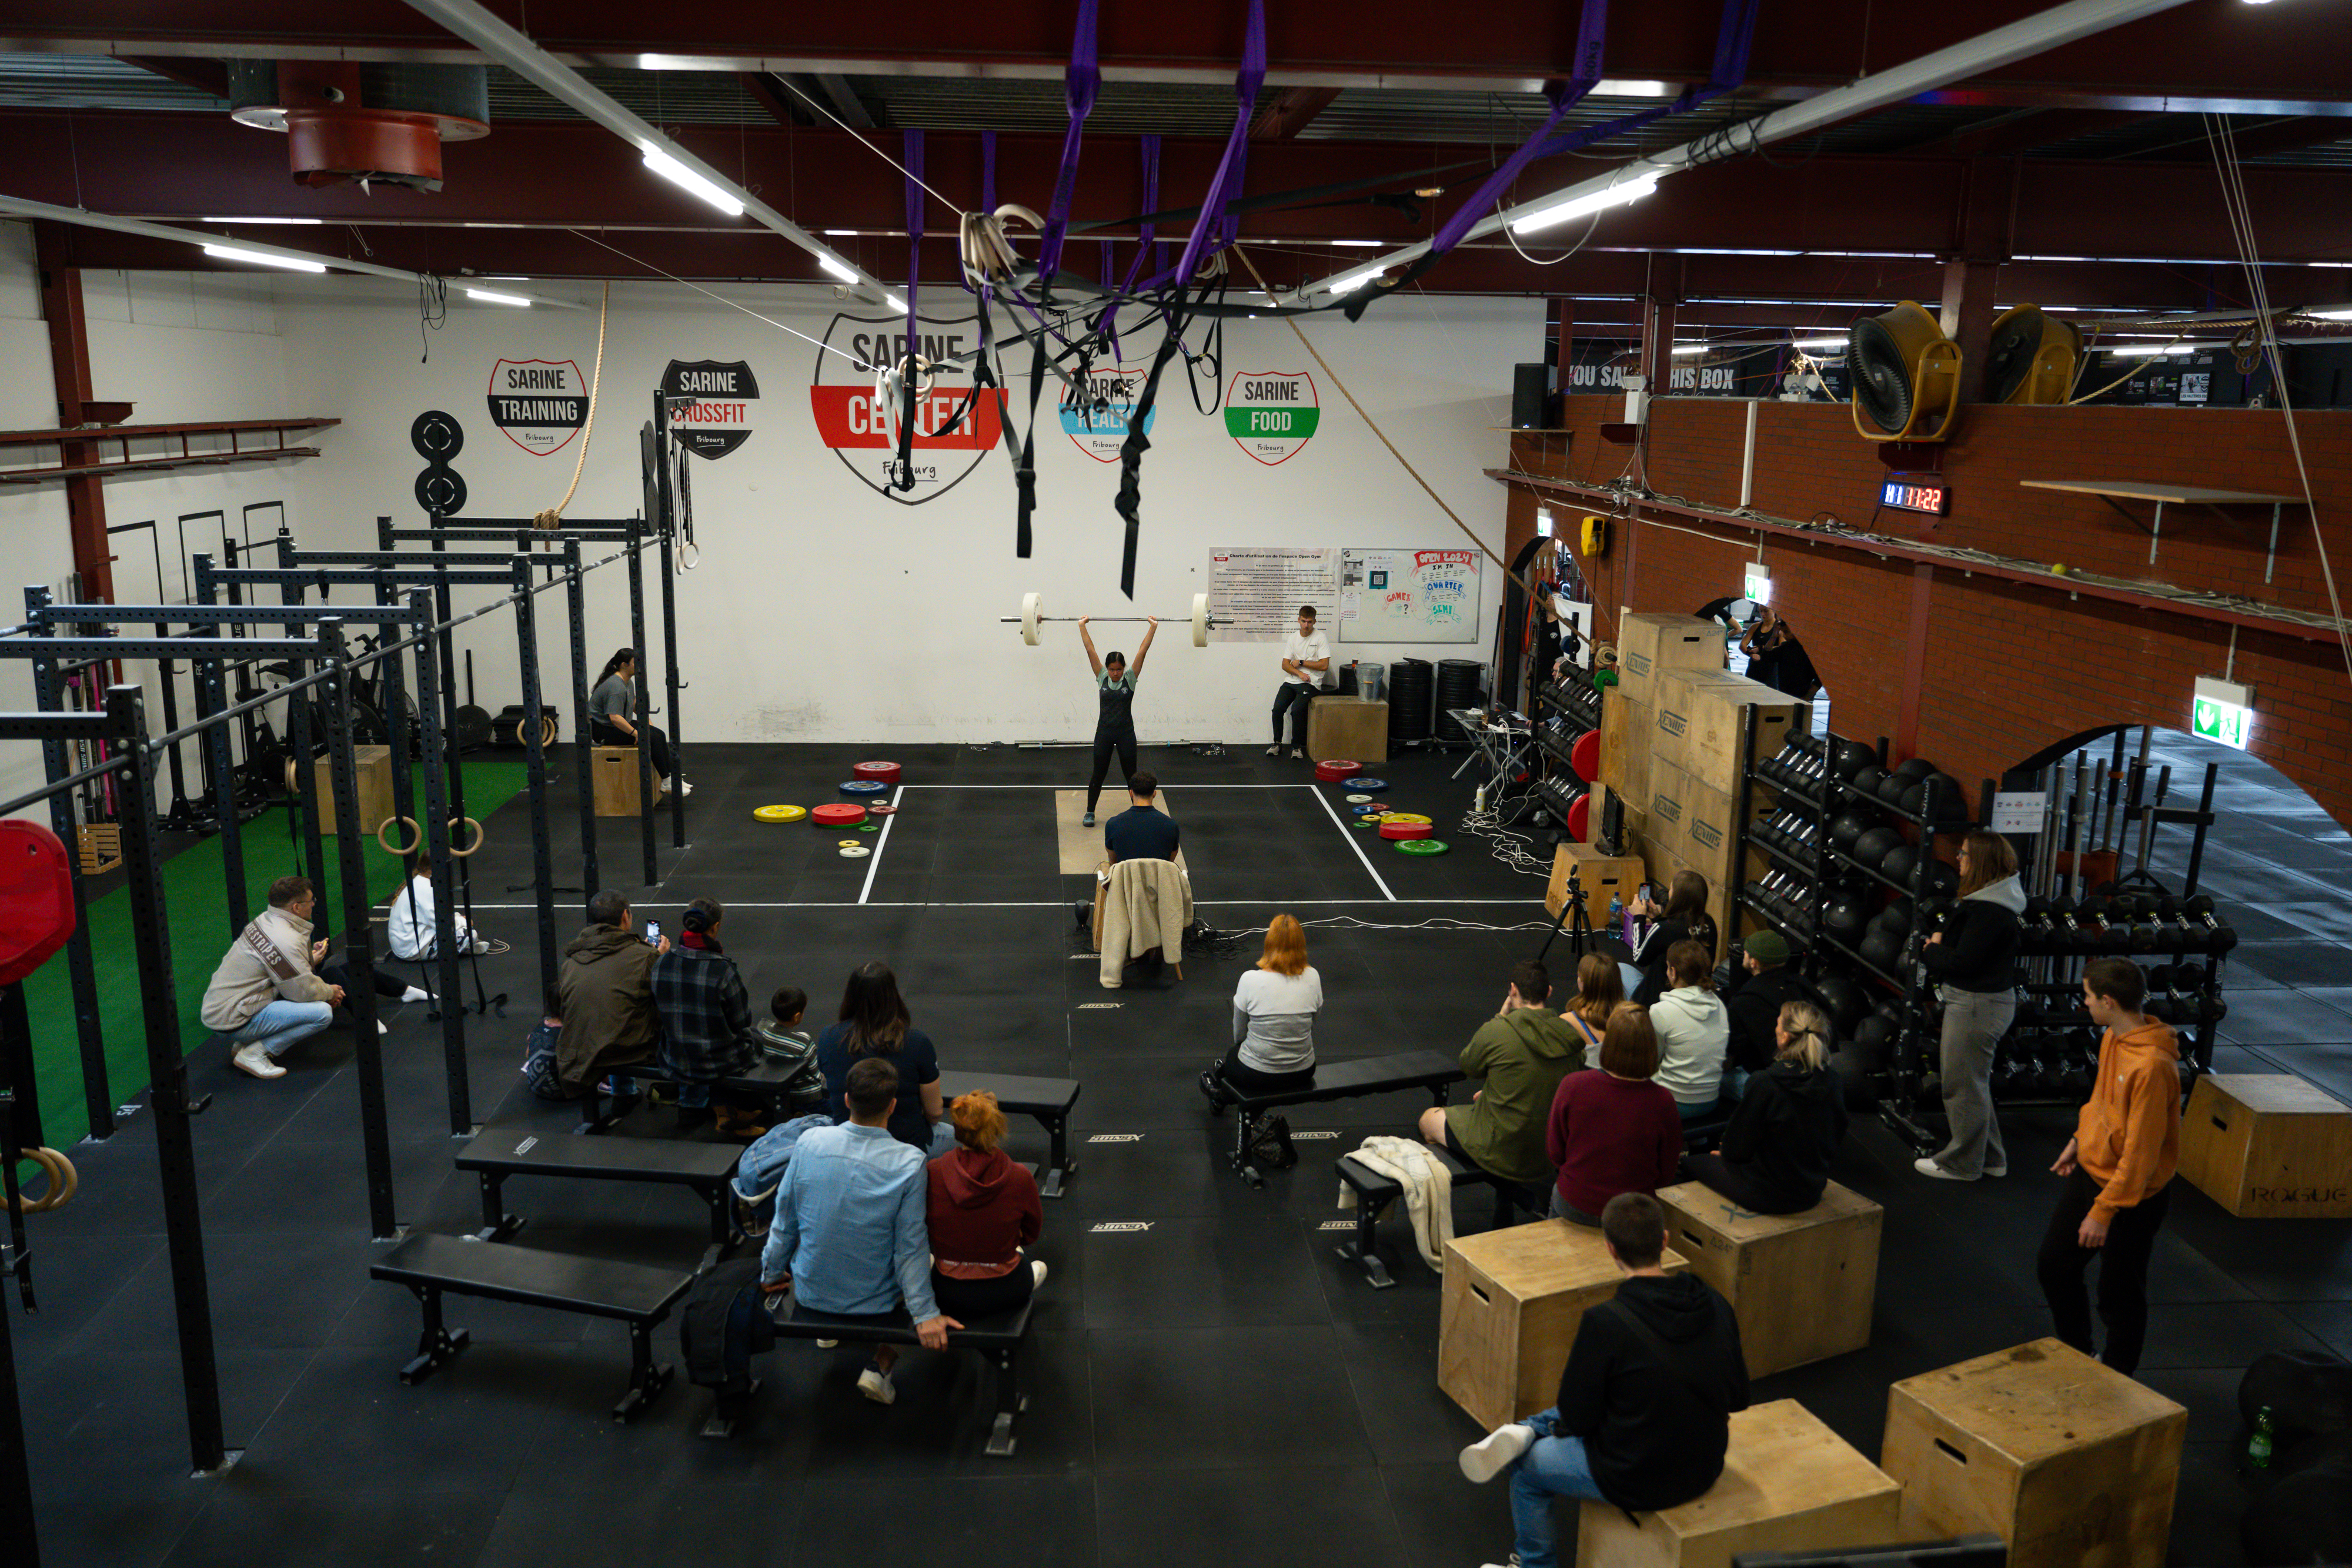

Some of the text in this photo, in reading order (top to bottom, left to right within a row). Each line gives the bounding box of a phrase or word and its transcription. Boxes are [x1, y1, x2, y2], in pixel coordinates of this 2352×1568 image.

[507, 369, 566, 390] SARINE
[680, 371, 737, 392] SARINE
[1671, 369, 1695, 389] HIS
[1700, 369, 1734, 389] BOX
[1245, 381, 1299, 401] SARINE
[499, 400, 577, 421] TRAINING
[1251, 412, 1291, 432] FOOD
[526, 433, 554, 443] Fribourg
[696, 435, 724, 444] Fribourg
[1093, 440, 1120, 450] Fribourg
[1257, 443, 1284, 452] Fribourg
[1419, 553, 1469, 563] OPEN 2024
[1427, 581, 1462, 592] QUARTER
[1387, 591, 1411, 602] GAMES
[1432, 604, 1452, 615] SEMI
[1623, 651, 1652, 677] XENIUS
[1656, 708, 1688, 738] XENIUS
[1651, 792, 1682, 824] XENIUS
[1687, 816, 1723, 851] XENIUS
[250, 931, 282, 965] STRIPES
[1085, 1134, 1145, 1142] XENIUS
[2251, 1188, 2347, 1202] ROGUE
[1087, 1222, 1155, 1232] XENIUS
